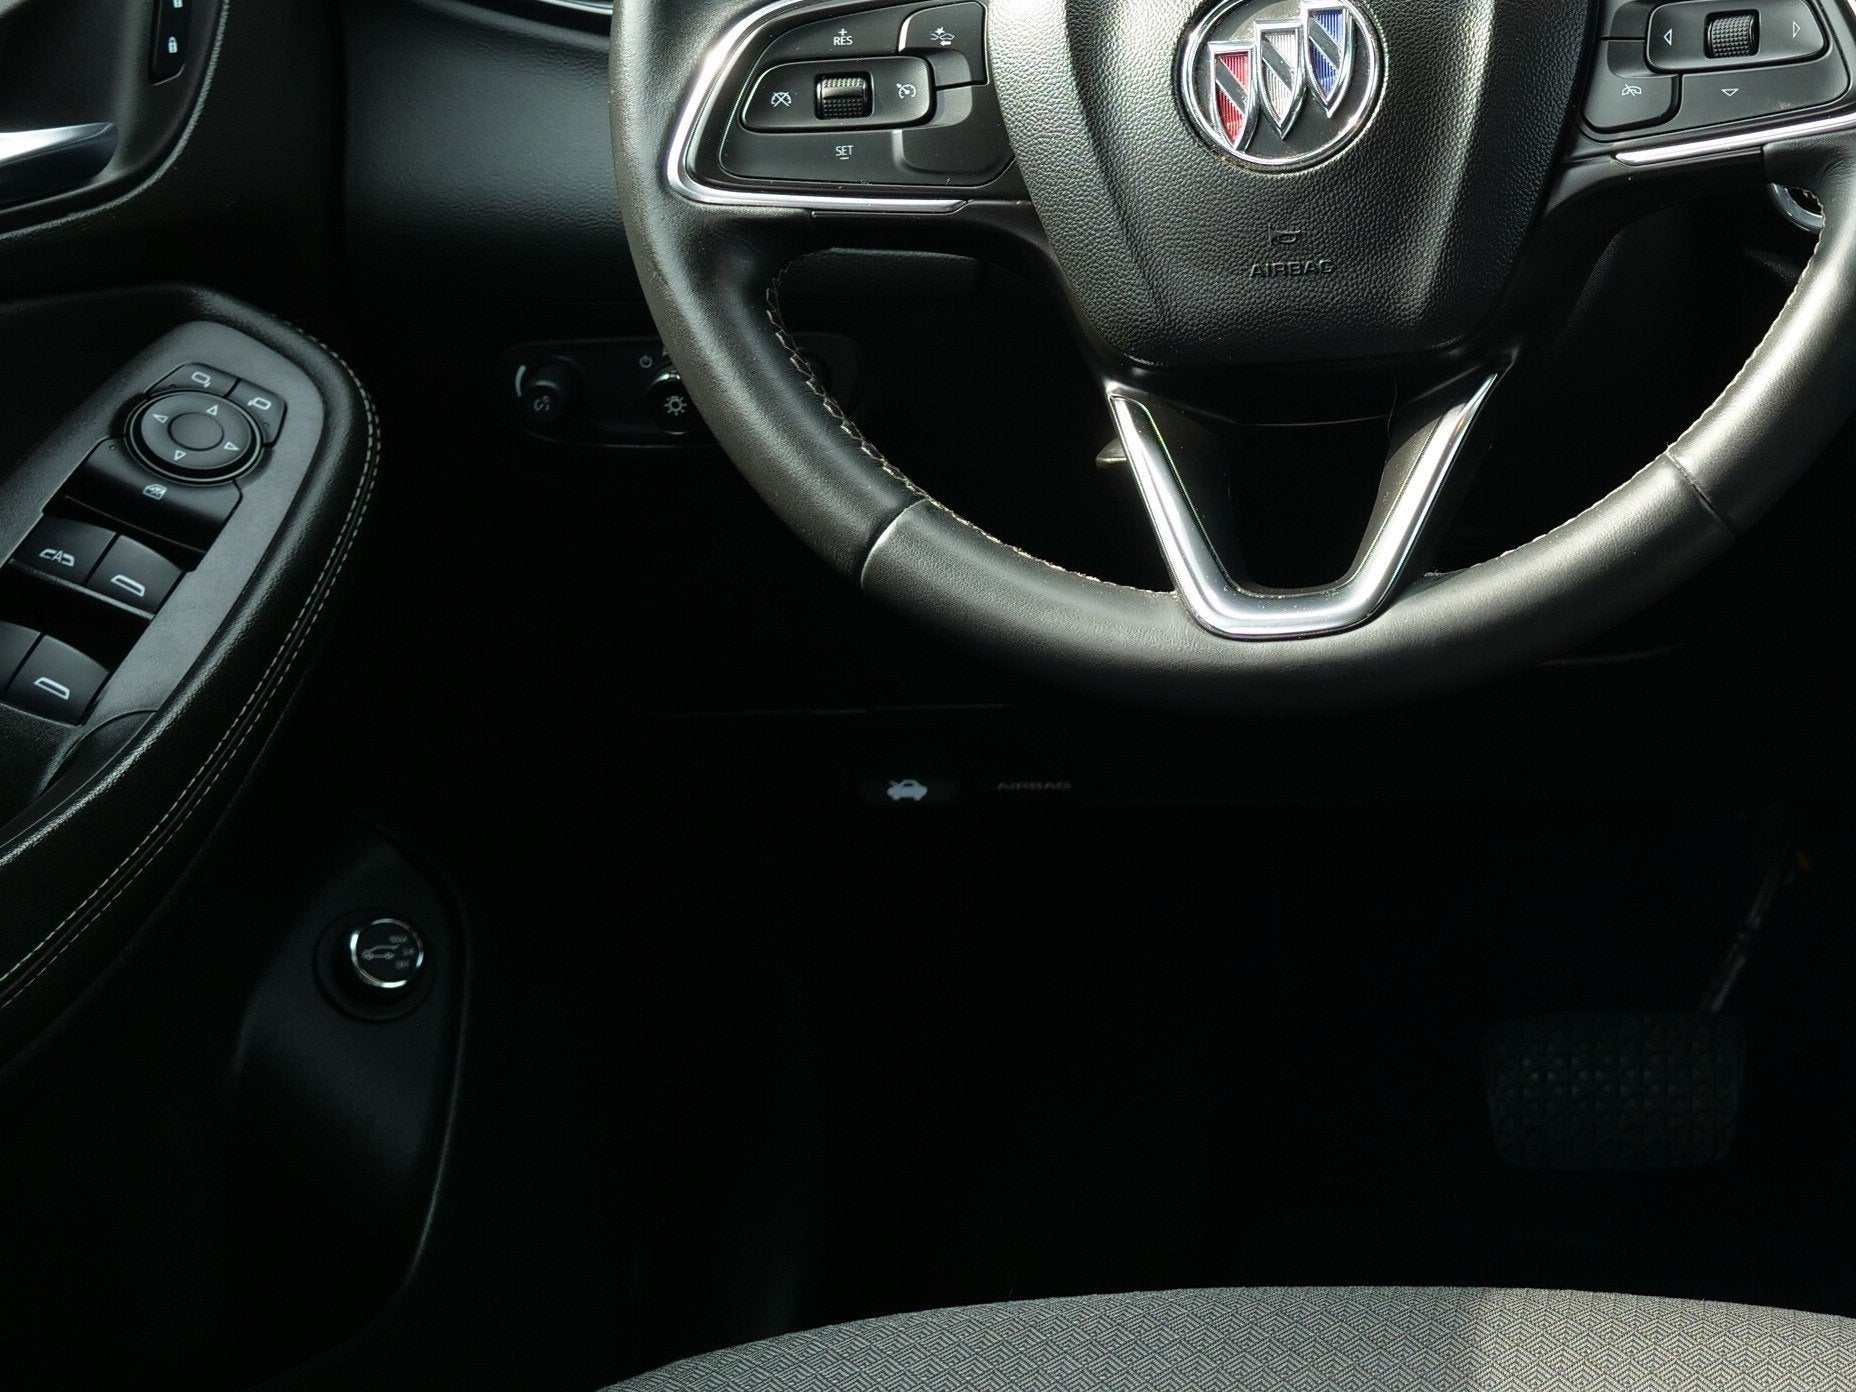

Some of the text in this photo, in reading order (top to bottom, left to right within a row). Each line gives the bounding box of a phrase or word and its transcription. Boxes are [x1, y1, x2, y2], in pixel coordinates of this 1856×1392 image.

[833, 34, 854, 46] RES
[835, 145, 855, 157] SET
[1249, 259, 1337, 279] AIRBAG
